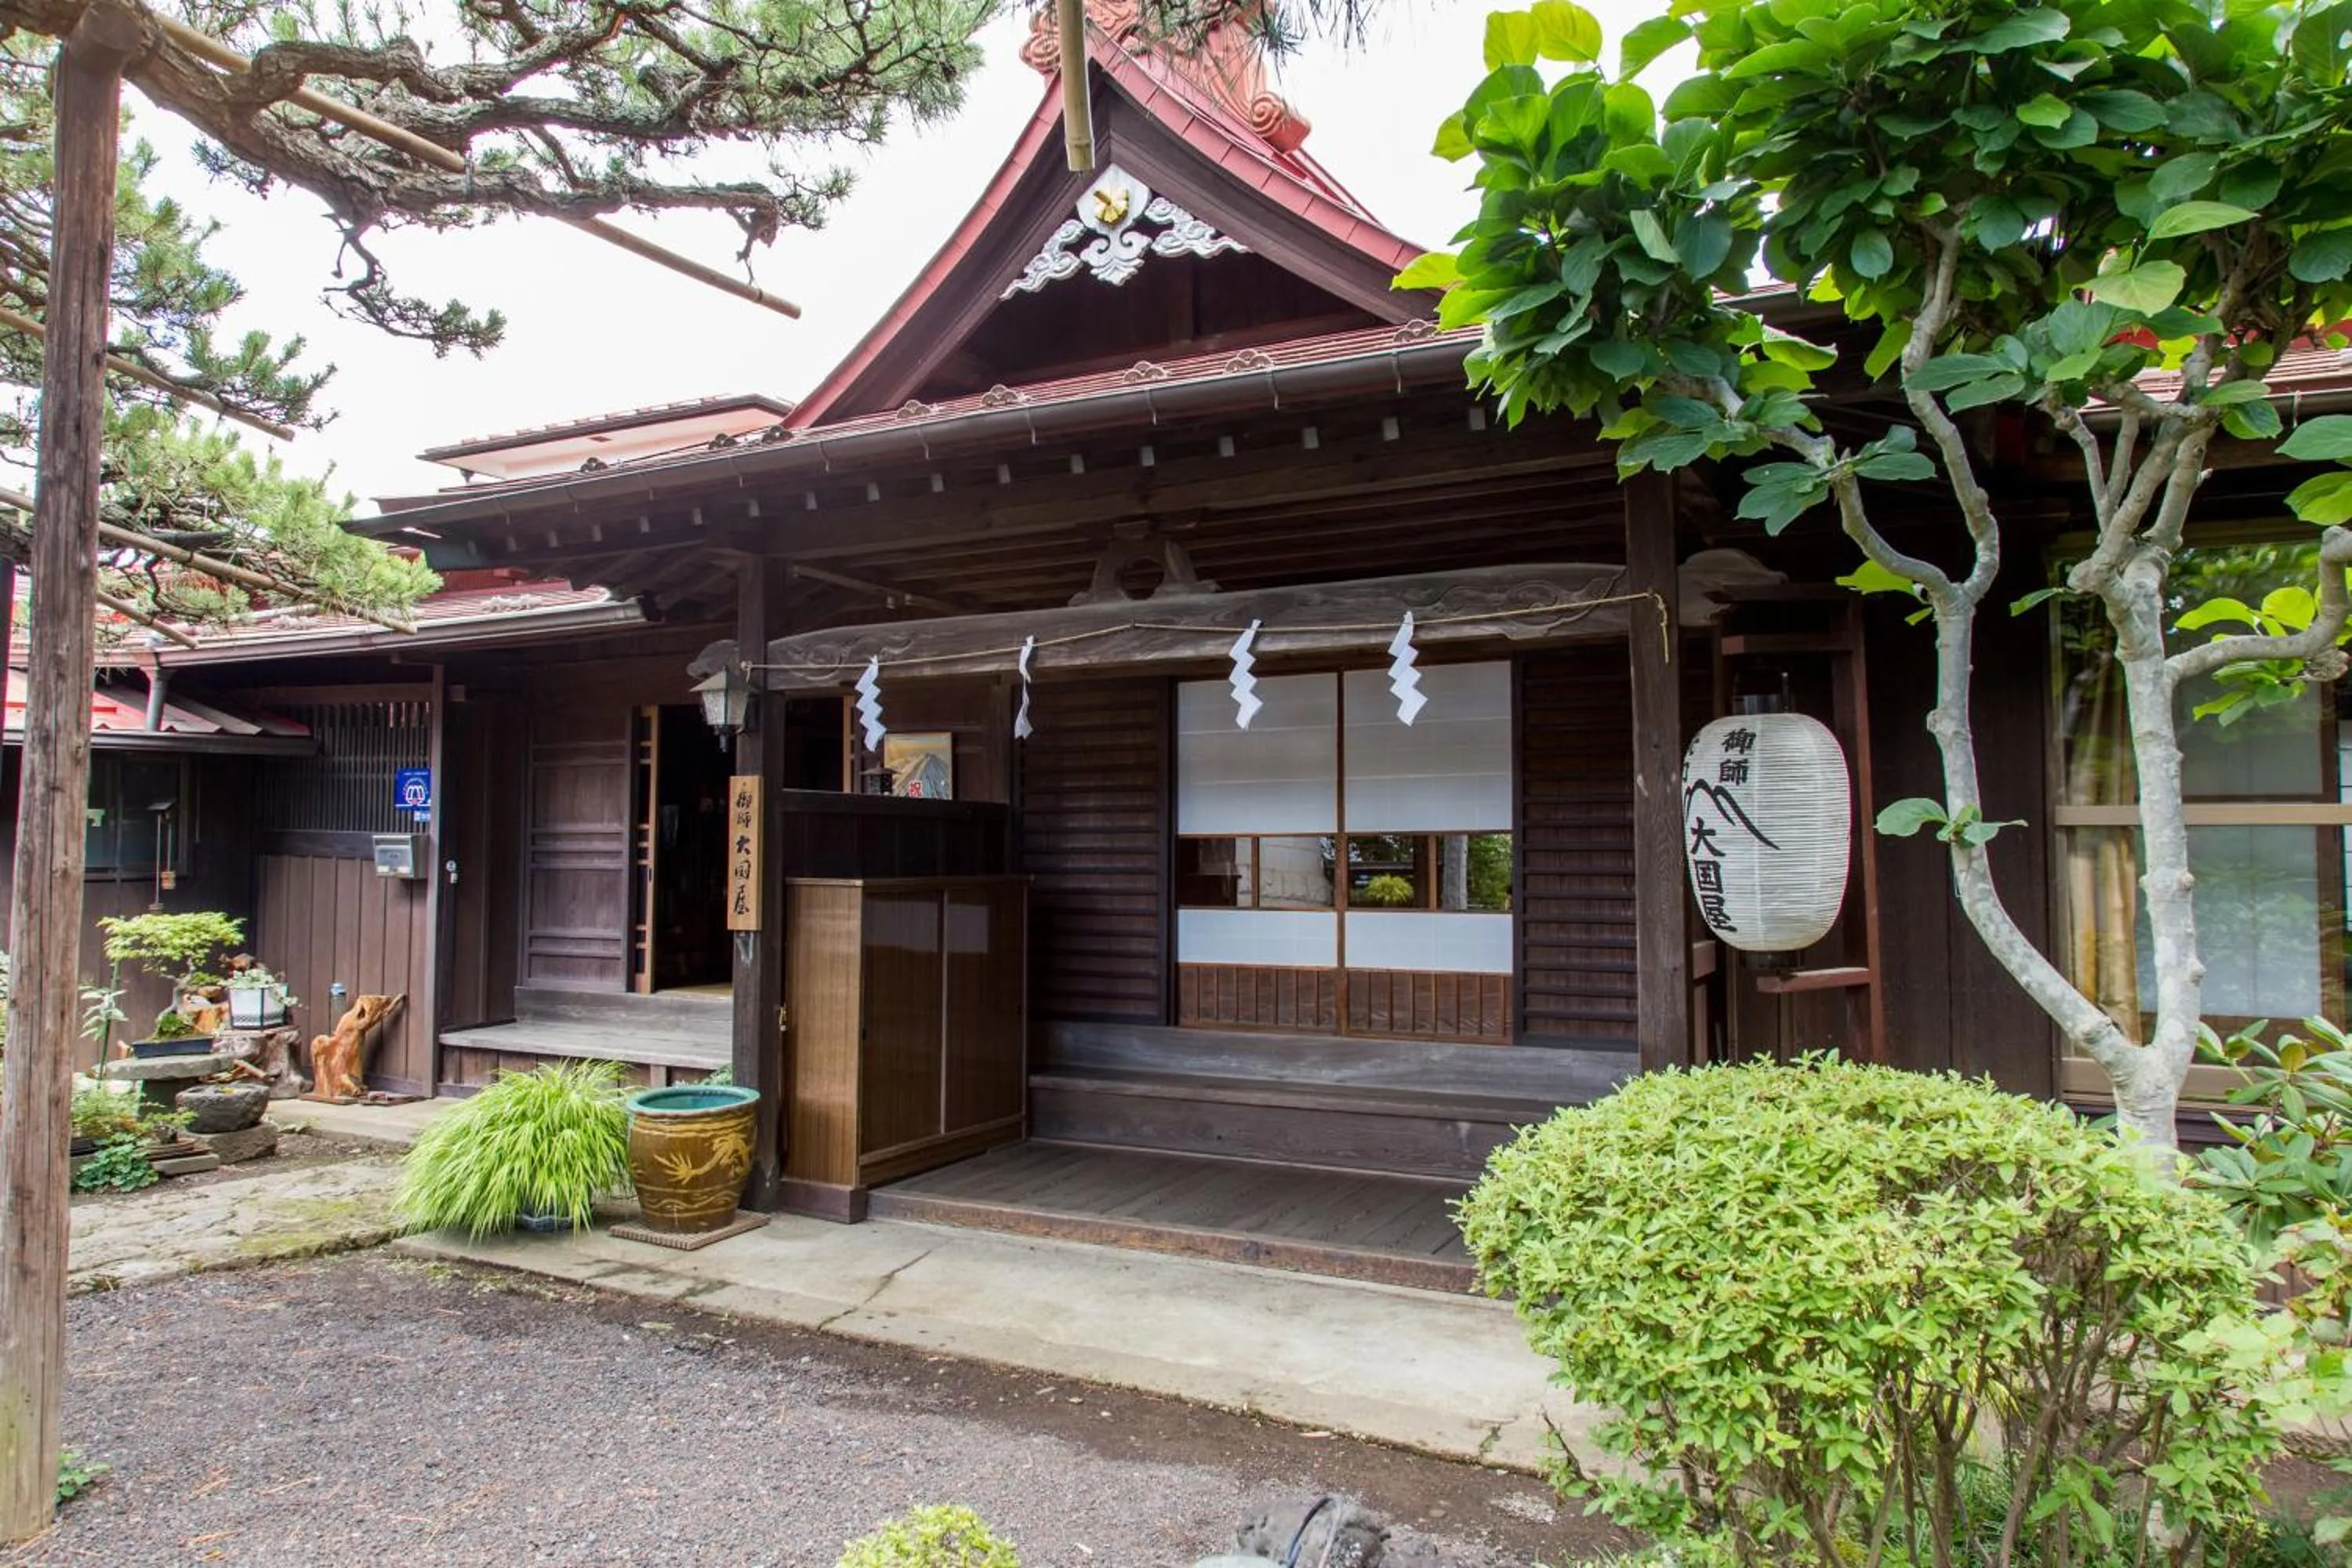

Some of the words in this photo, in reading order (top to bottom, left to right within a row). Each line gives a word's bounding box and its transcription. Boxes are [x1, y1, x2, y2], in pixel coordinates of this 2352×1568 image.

[1719, 728, 1756, 786] 御師
[1690, 816, 1737, 932] 大国屋
